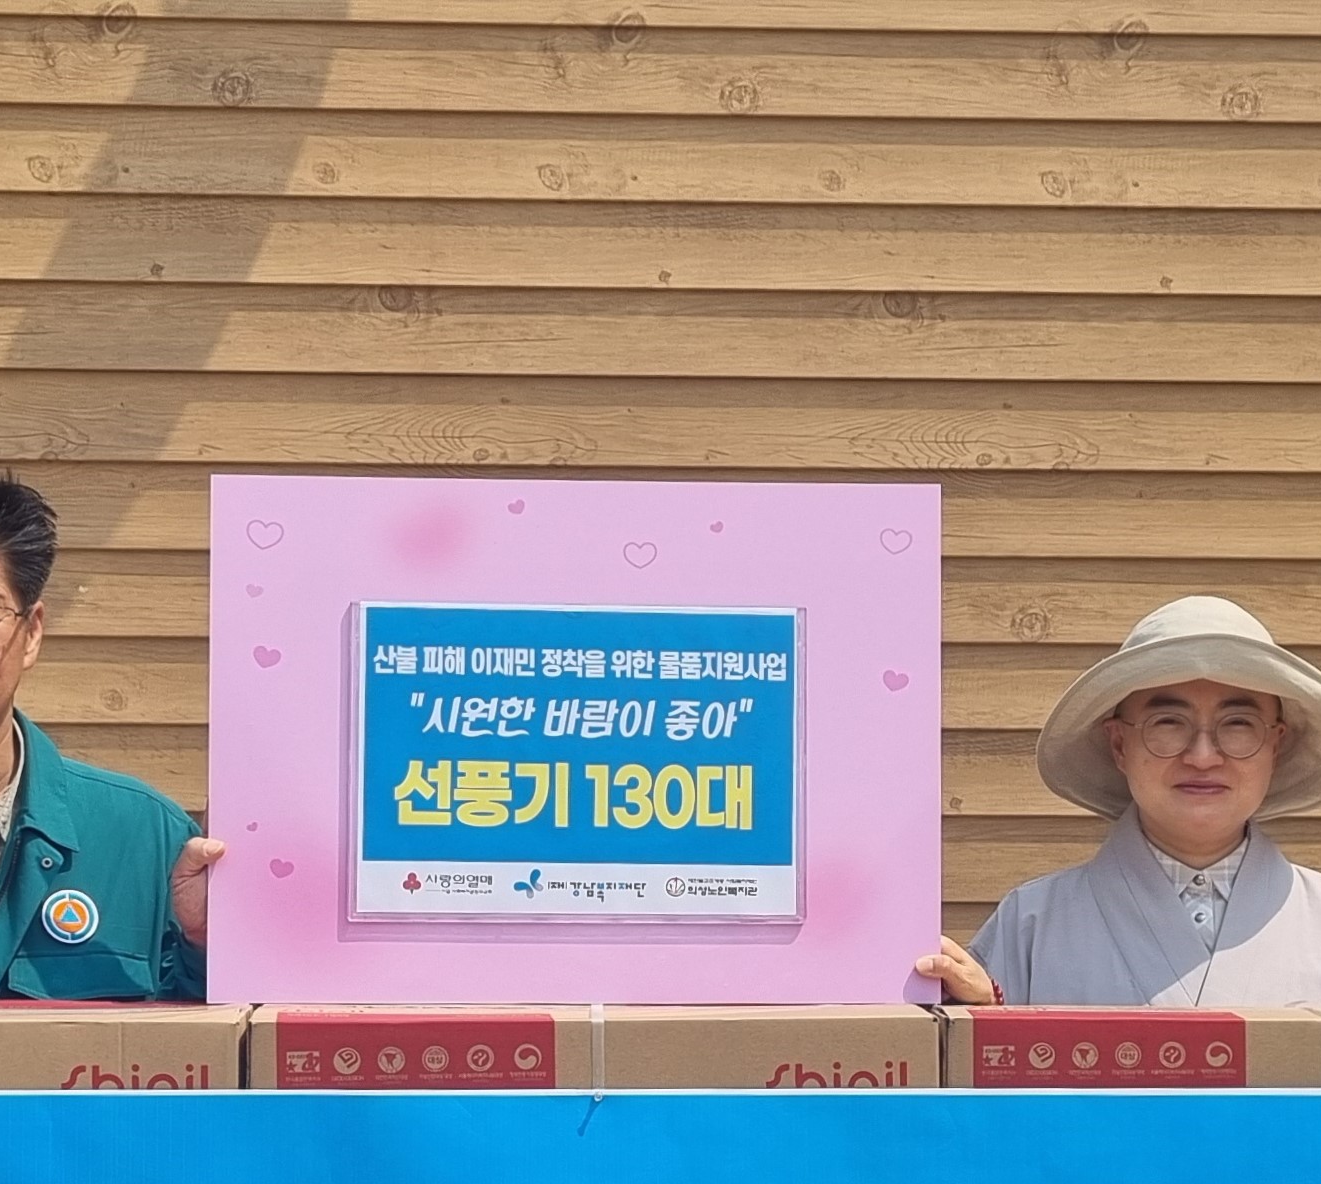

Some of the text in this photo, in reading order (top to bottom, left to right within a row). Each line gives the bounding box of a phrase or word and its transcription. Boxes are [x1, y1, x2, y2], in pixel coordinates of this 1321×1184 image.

[373, 645, 787, 682] 산불 피해 이재민 정착을 위한 물품지원사업
[410, 692, 754, 742] "시원한 바람이 좋아"
[394, 759, 753, 831] 선풍기 130대
[425, 874, 493, 889] 사랑의열매
